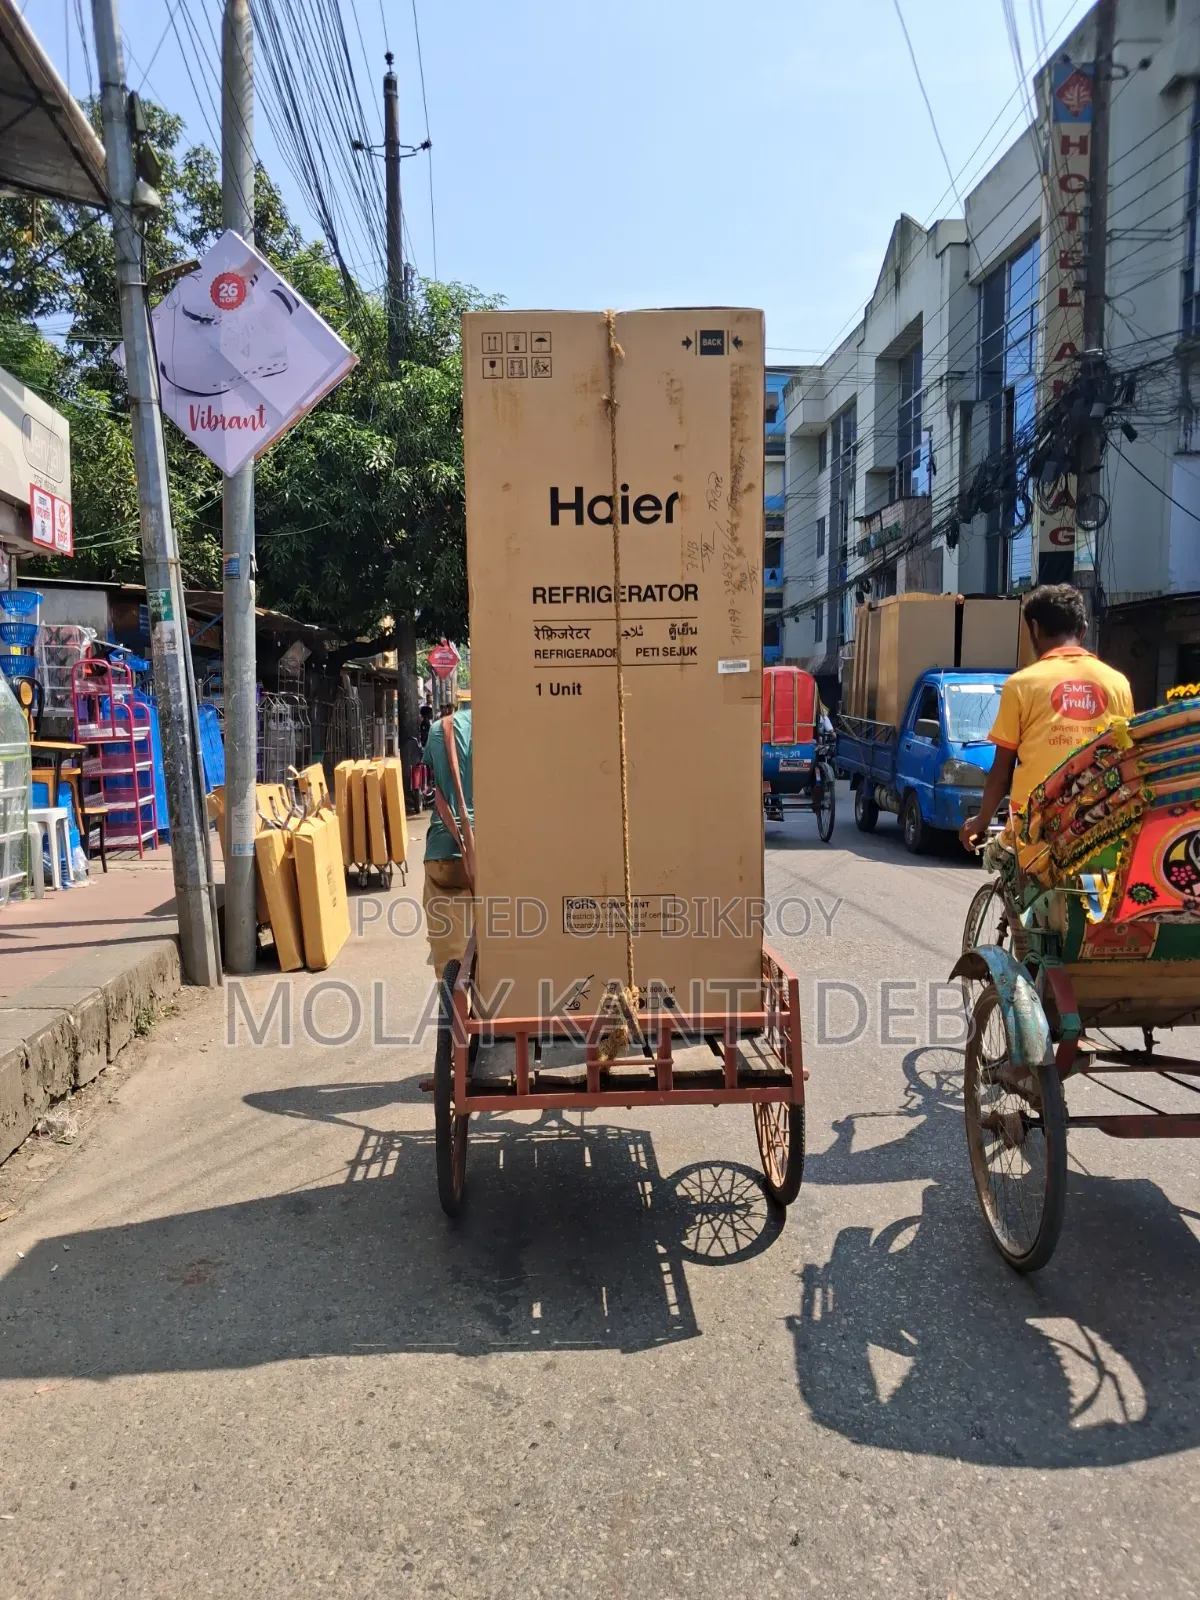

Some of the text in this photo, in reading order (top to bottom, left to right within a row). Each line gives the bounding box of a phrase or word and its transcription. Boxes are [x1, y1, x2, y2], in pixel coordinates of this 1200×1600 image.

[1058, 134, 1089, 308] HOTEL
[218, 282, 239, 297] 26
[702, 338, 722, 347] BACK
[189, 403, 268, 432] Vibrant
[550, 483, 679, 526] Haier
[532, 583, 699, 604] REFRIGERATOR
[668, 622, 698, 640] ตู้เย็น
[635, 646, 698, 657] PETI SEJUK
[535, 682, 582, 696] 1 Unit
[1063, 684, 1092, 693] SMC
[1062, 693, 1097, 715] Fruity
[566, 899, 650, 910] RoHS COMPIANT
